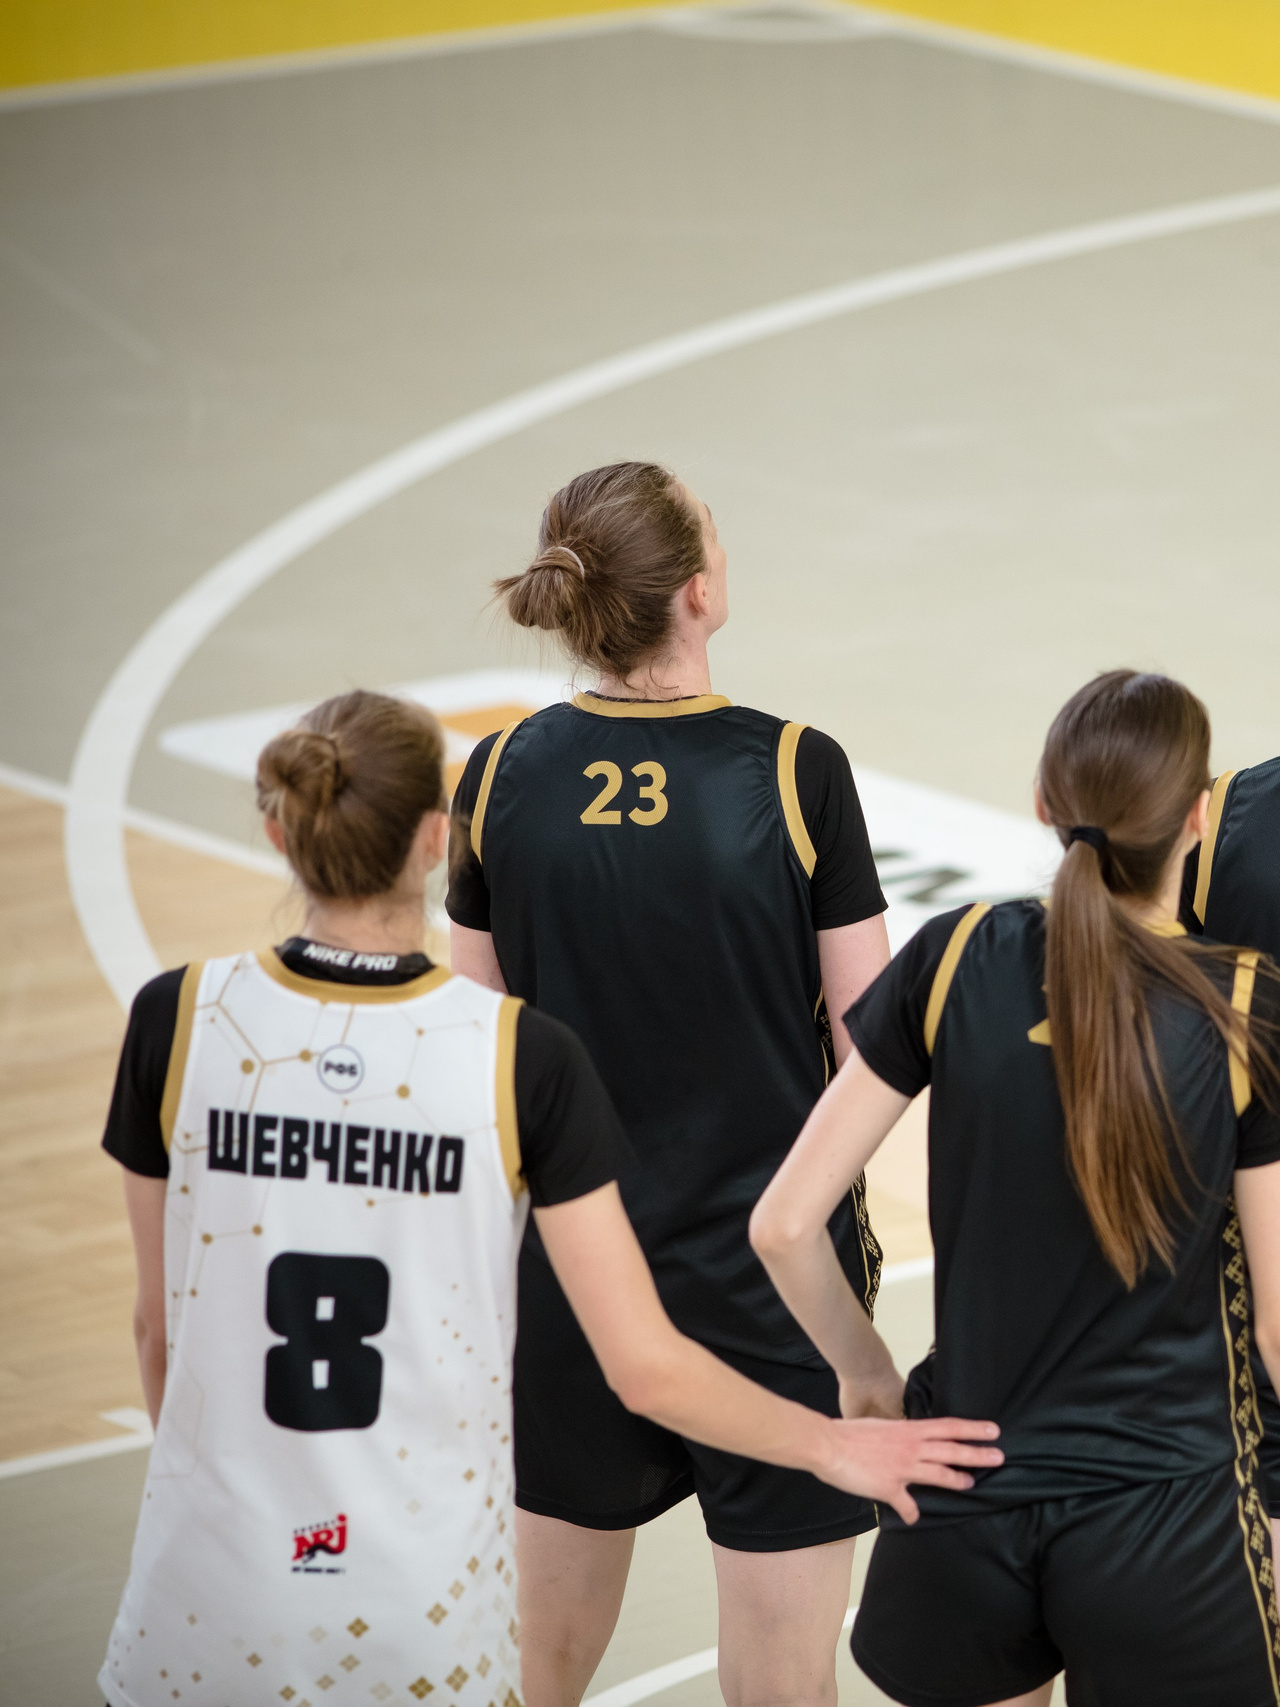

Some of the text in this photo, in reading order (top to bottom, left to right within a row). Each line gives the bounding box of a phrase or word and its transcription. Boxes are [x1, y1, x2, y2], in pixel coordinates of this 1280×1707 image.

[580, 761, 669, 826] 23
[302, 943, 399, 971] NIKE PRO
[207, 1107, 465, 1194] ШЕВЧЕНКО
[263, 1252, 391, 1432] 8
